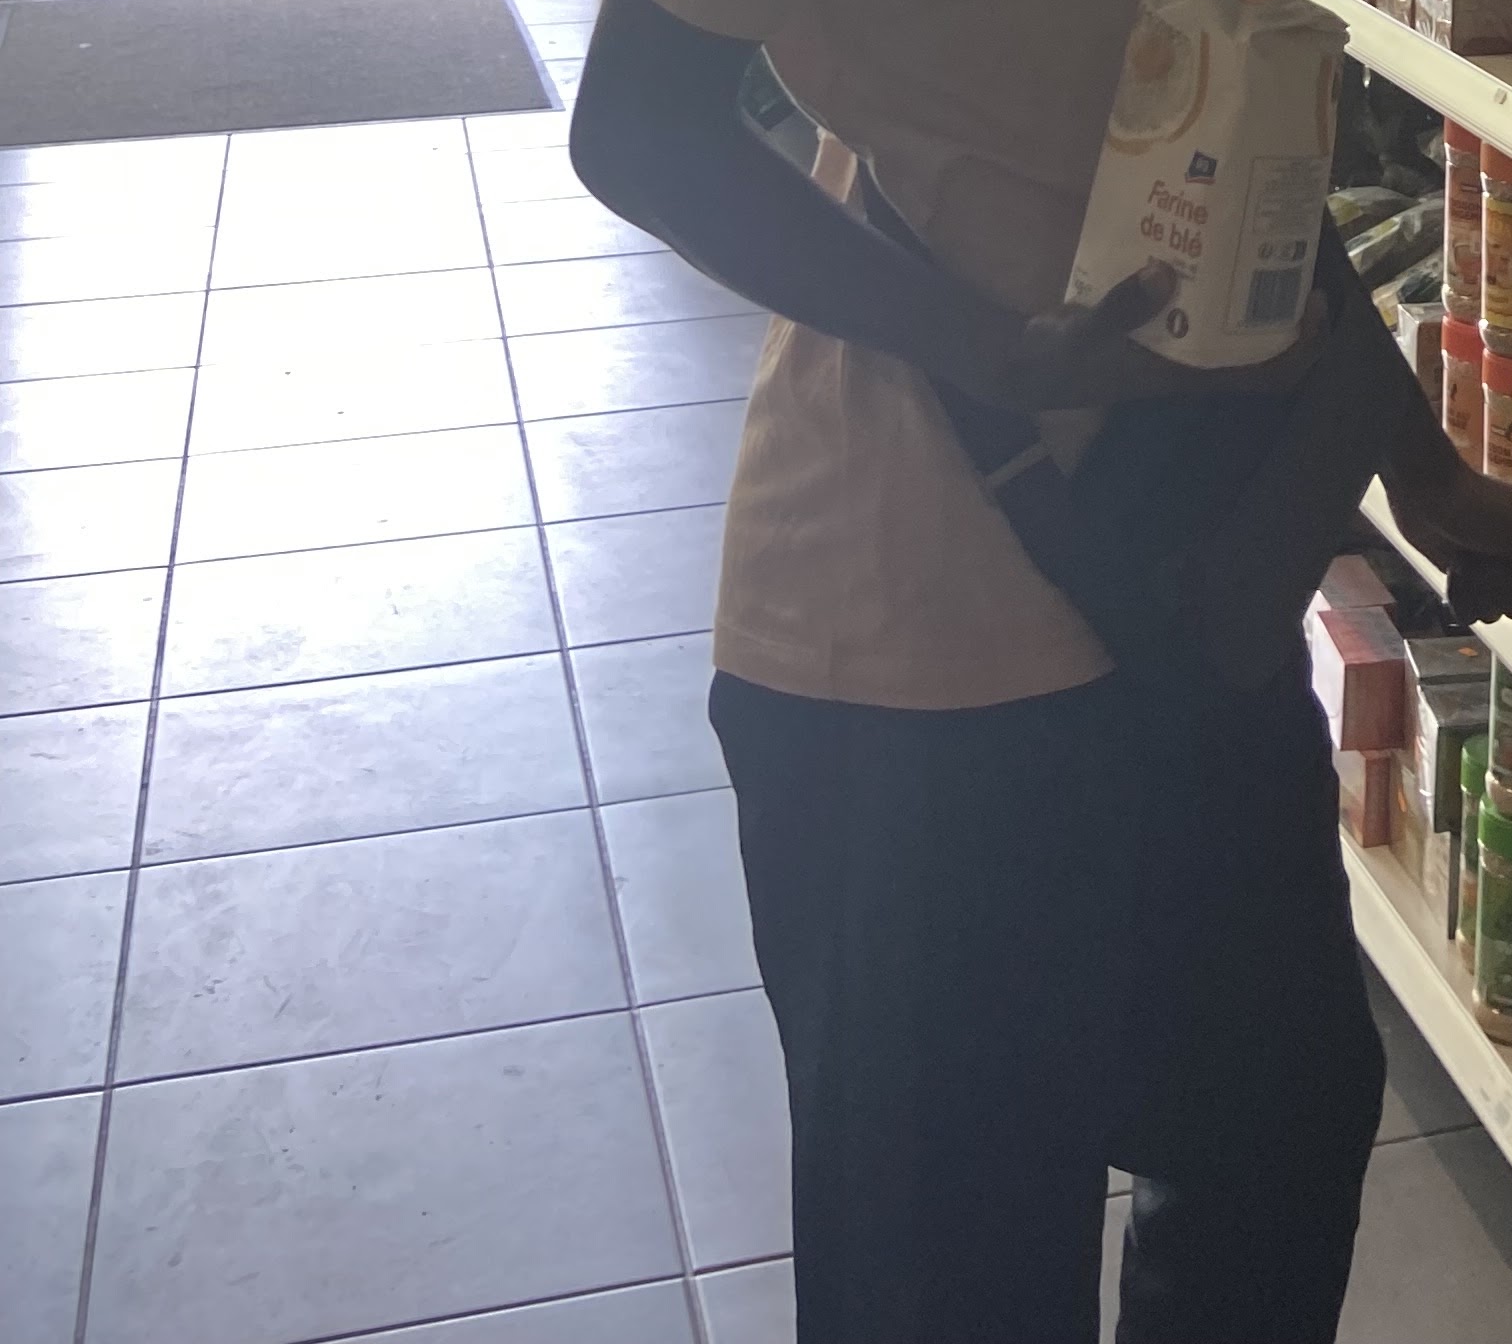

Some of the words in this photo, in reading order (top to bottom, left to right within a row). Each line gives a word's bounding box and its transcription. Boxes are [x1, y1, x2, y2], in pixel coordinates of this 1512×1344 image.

[1146, 178, 1209, 226] Farine
[1139, 212, 1165, 243] de
[1168, 222, 1204, 258] blé
